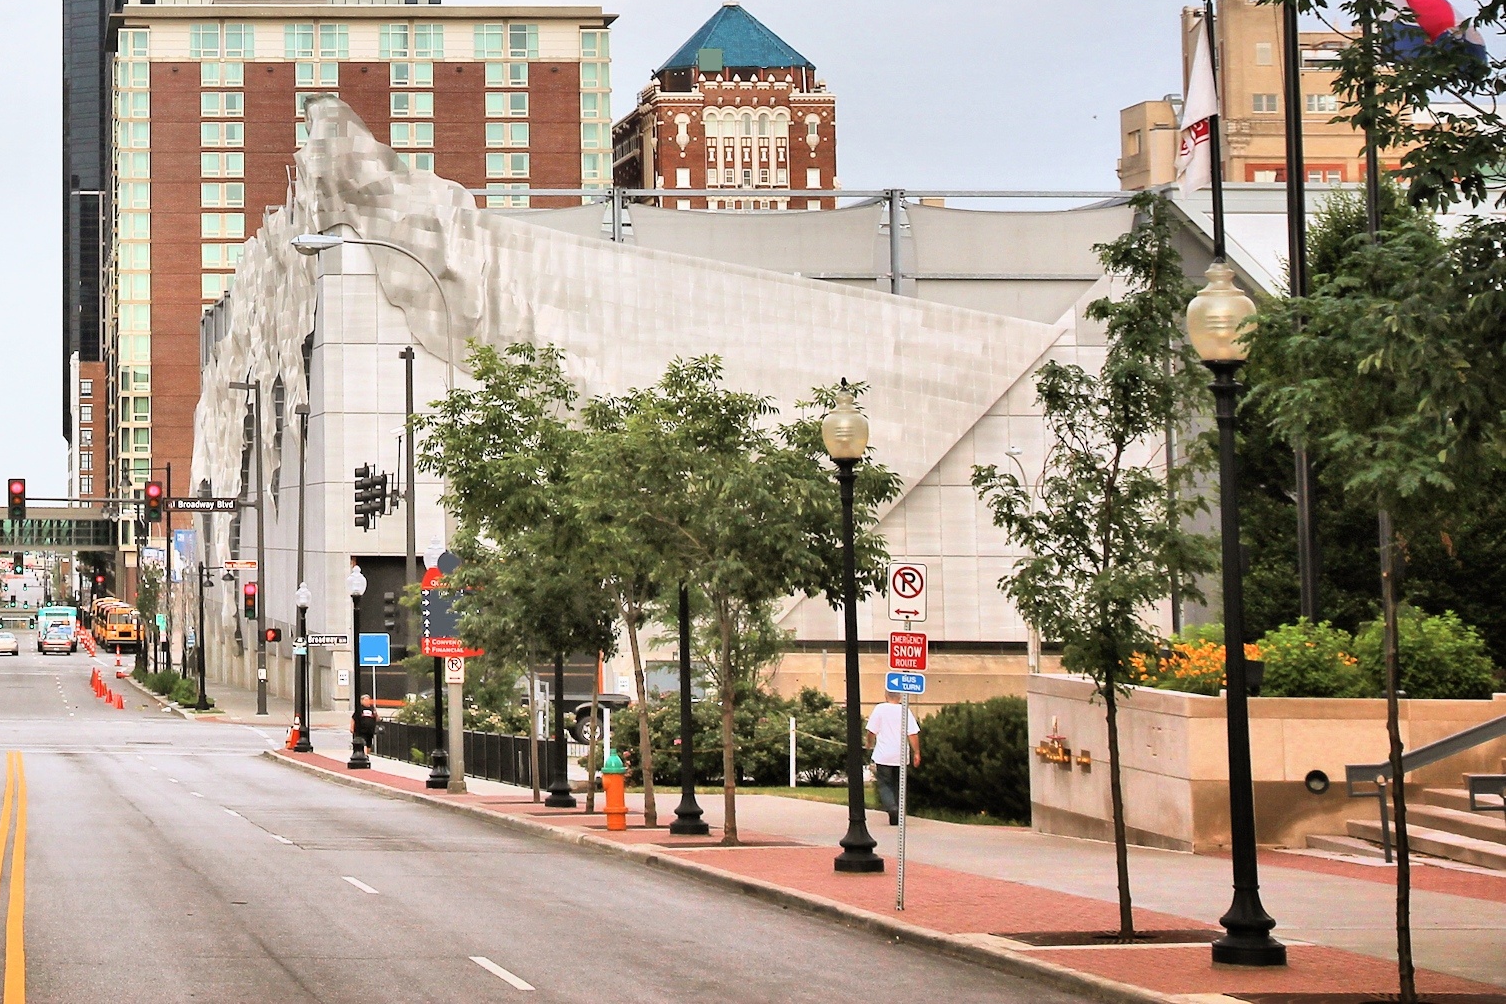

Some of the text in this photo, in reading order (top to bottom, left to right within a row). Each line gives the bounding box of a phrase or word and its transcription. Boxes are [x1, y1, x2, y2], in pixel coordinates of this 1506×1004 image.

[177, 500, 234, 510] Broadway Blvd
[891, 635, 924, 645] EMERGENCY
[893, 645, 923, 657] SNOW
[895, 659, 917, 667] ROUTE
[901, 675, 916, 683] BUS
[902, 683, 921, 691] TURN
